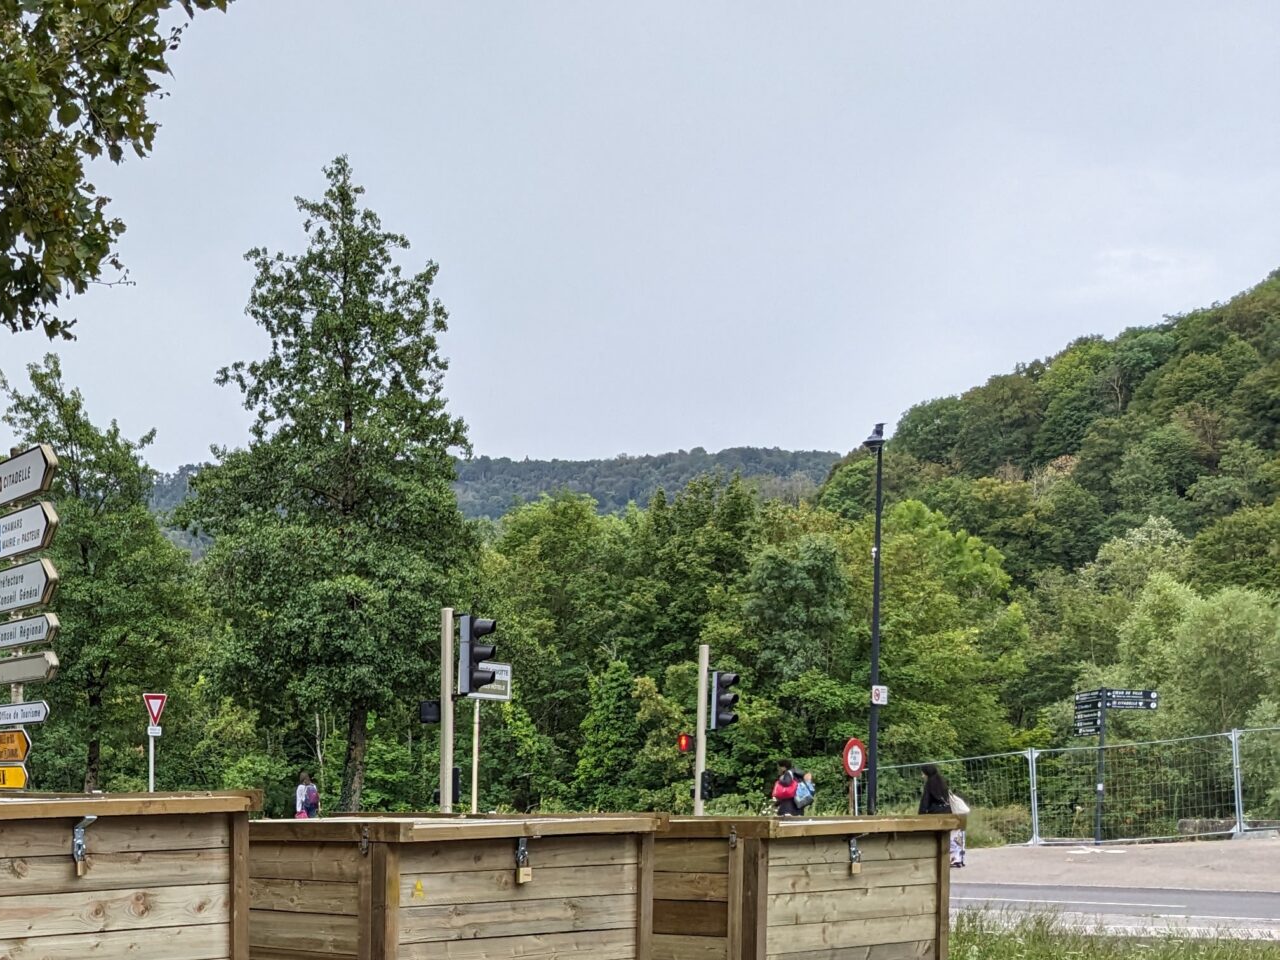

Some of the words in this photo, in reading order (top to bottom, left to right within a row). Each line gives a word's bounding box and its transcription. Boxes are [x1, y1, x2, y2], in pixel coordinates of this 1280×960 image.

[3, 466, 31, 488] CITADELLE
[2, 519, 23, 534] CHAMARS
[2, 536, 16, 549] MAIRIE
[21, 529, 40, 544] PASTEUR
[19, 584, 40, 601] Général
[19, 621, 44, 639] Régional
[0, 711, 11, 720] Office
[13, 710, 18, 719] de
[20, 708, 41, 719] Tourisme
